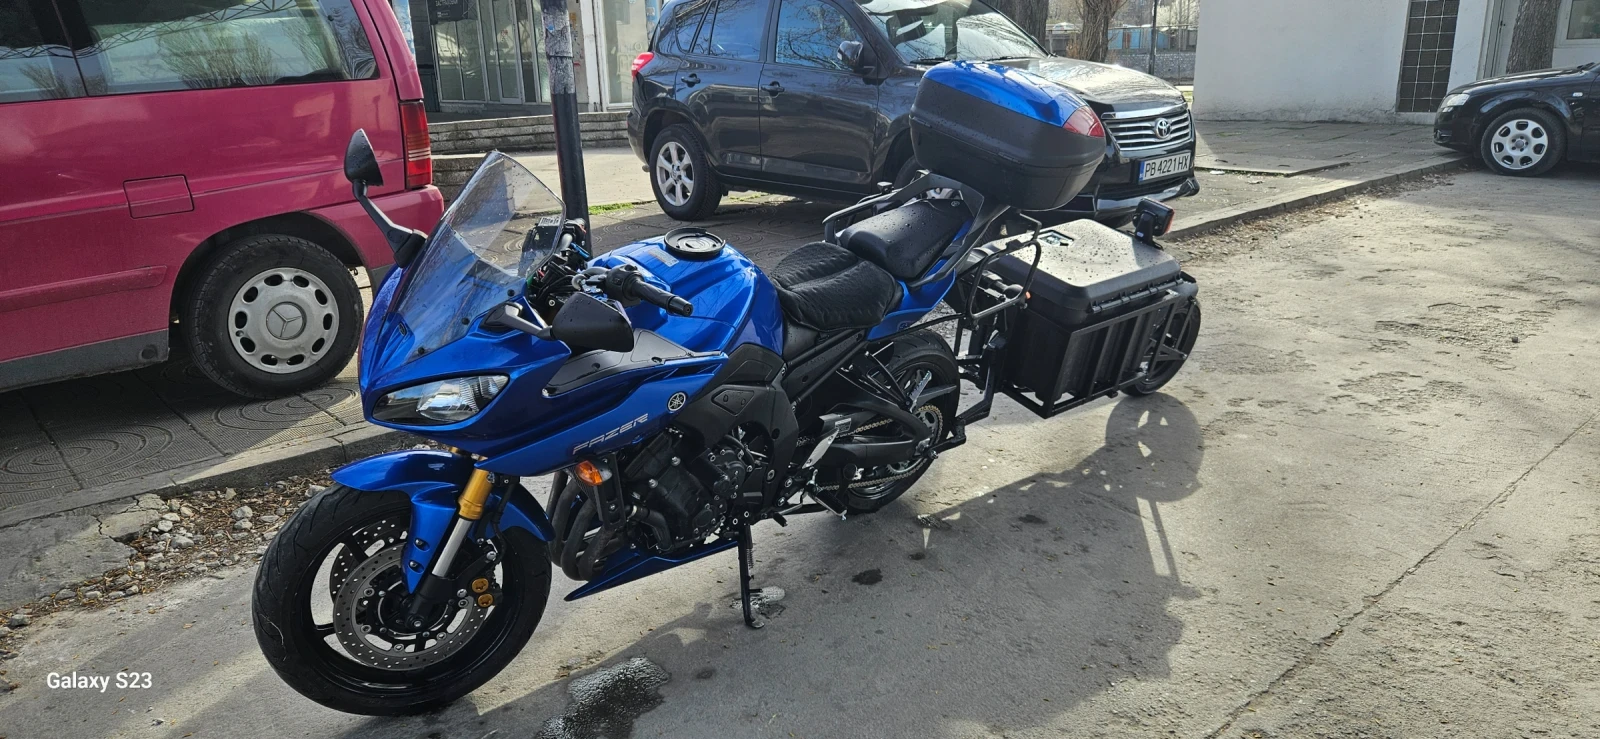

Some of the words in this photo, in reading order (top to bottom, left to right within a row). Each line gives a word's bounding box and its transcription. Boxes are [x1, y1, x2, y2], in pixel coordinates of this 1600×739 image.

[1145, 162, 1156, 177] PB
[1157, 157, 1177, 175] 4221
[1177, 154, 1190, 171] HX
[572, 413, 649, 455] FAZER
